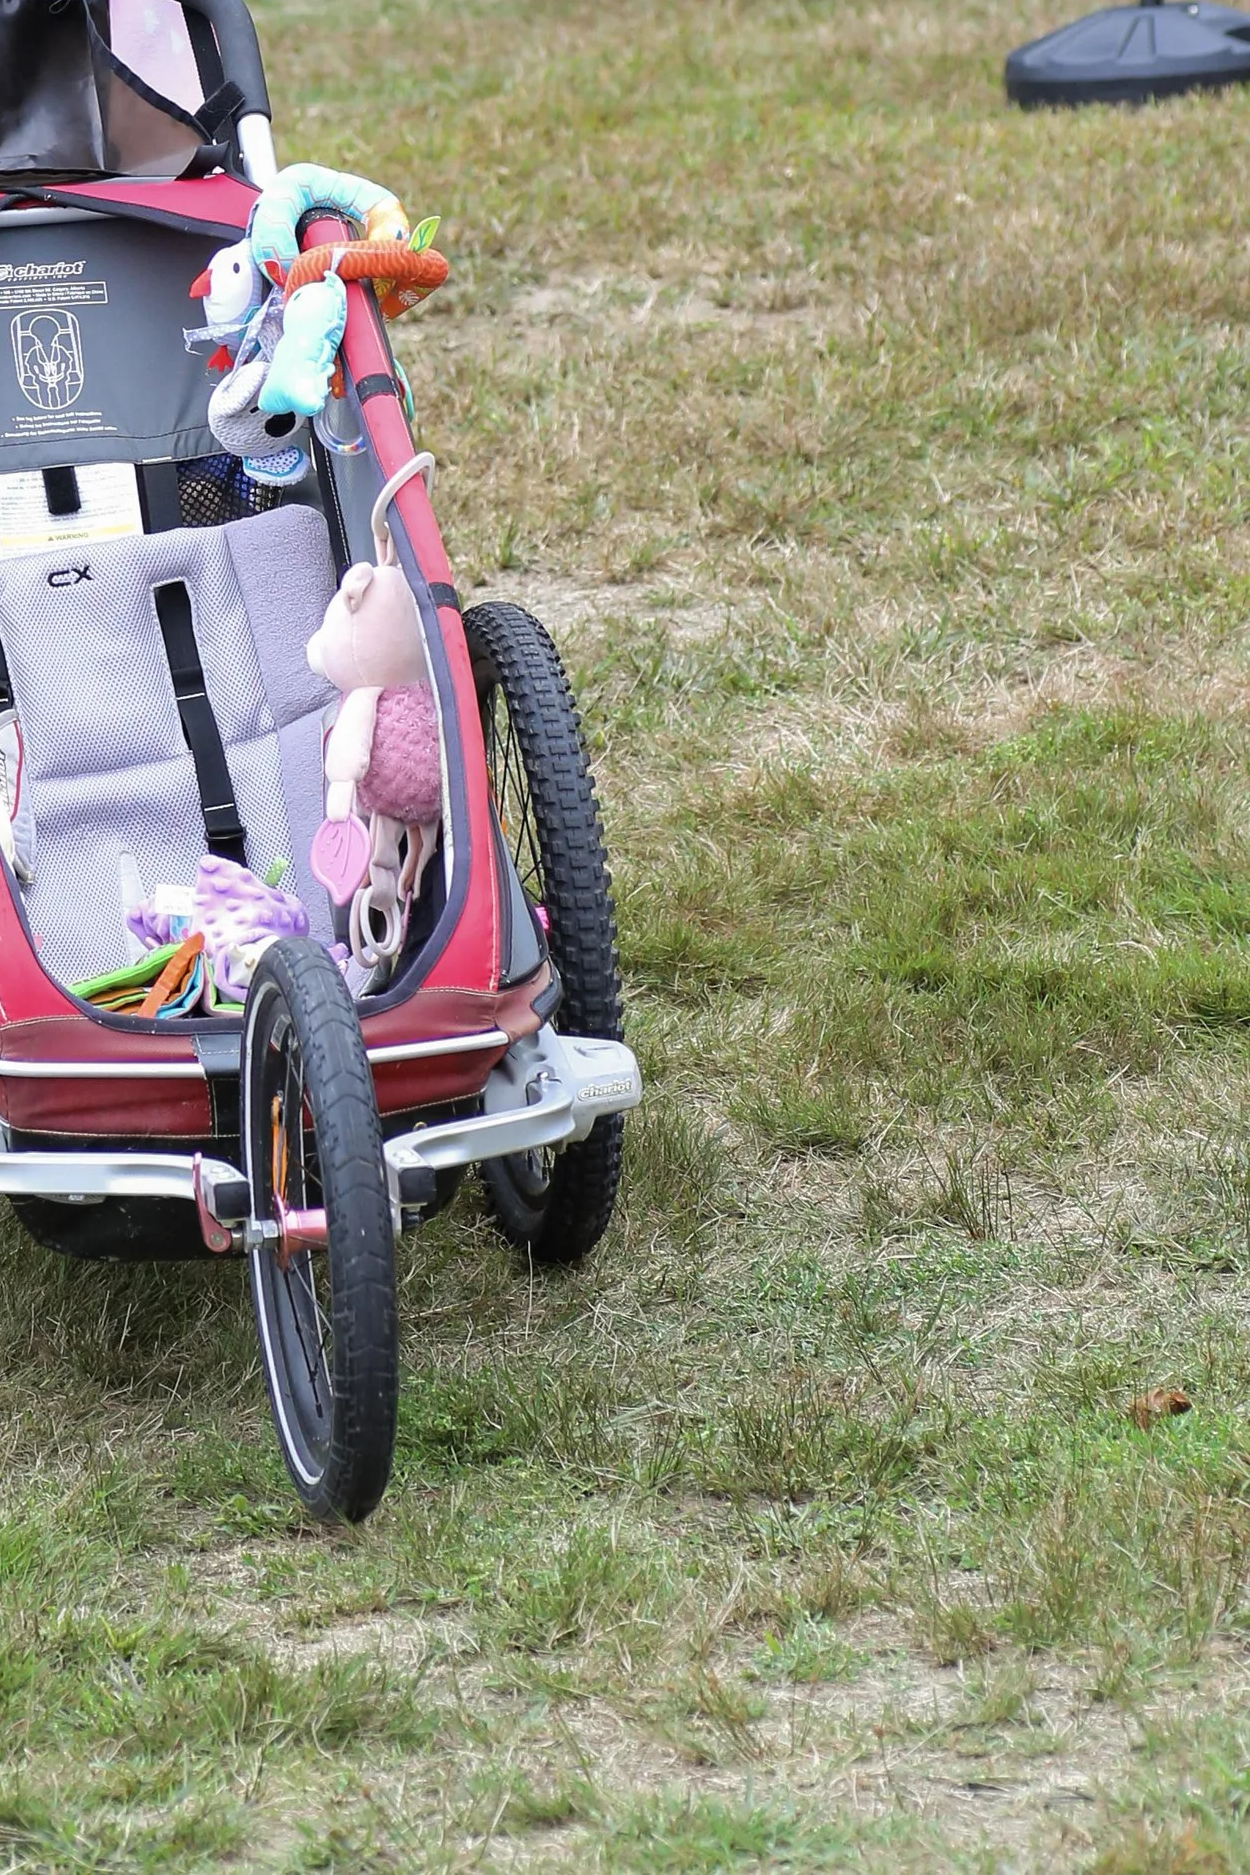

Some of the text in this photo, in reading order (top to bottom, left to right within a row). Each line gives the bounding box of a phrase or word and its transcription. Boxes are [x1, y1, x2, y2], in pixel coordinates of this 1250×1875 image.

[14, 262, 84, 278] chariot
[56, 533, 89, 542] WARNING
[47, 565, 93, 587] CX
[578, 1078, 631, 1100] chariot
